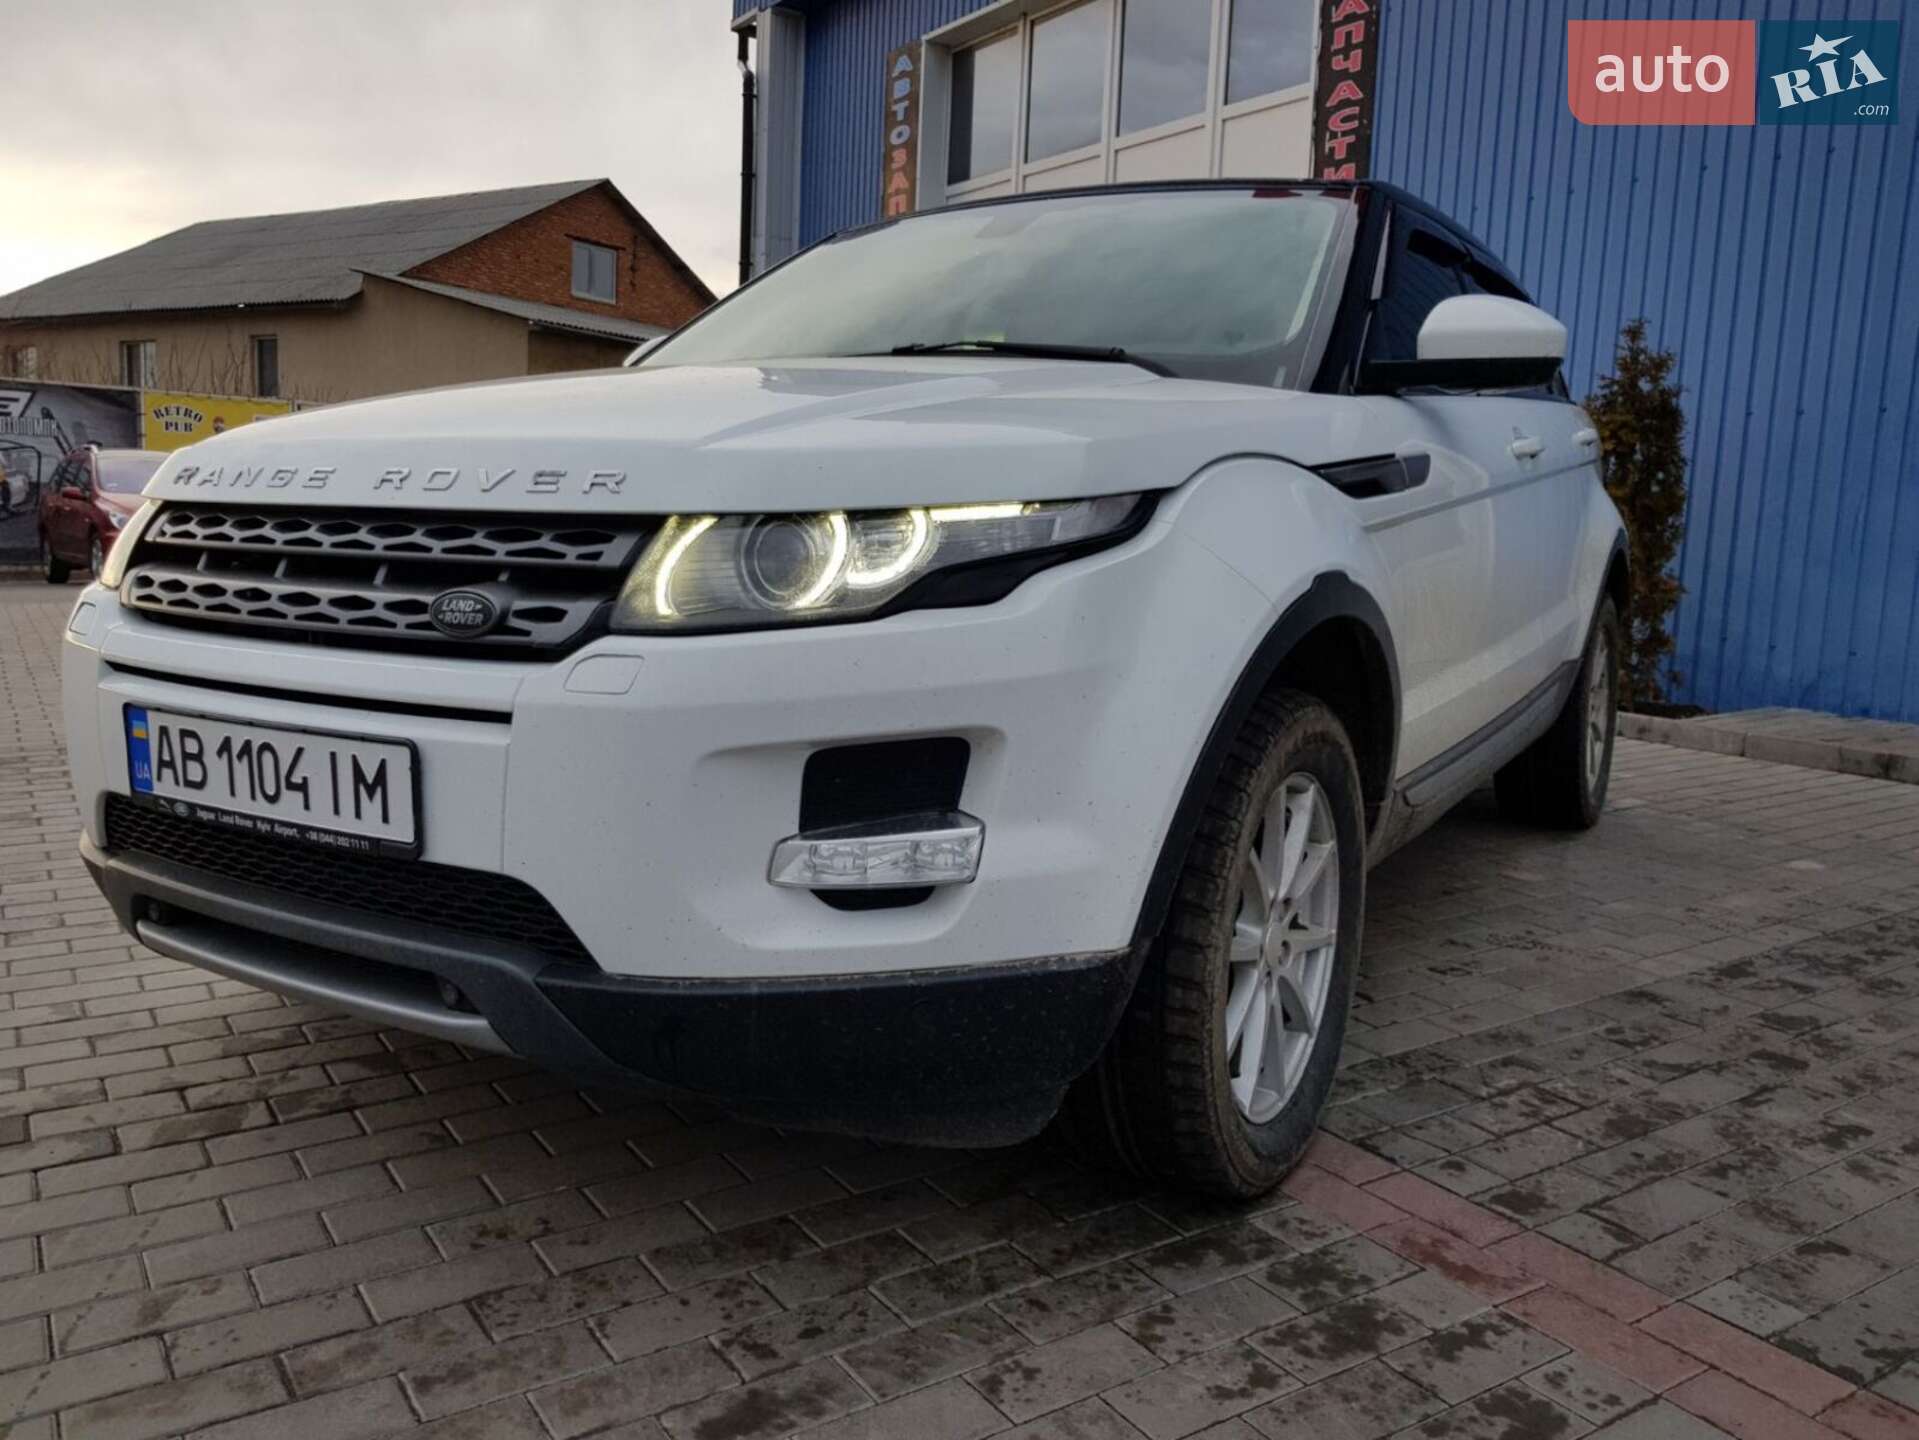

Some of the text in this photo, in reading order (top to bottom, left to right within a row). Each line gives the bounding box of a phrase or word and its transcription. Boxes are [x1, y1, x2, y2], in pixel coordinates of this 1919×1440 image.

[153, 405, 203, 423] RETRO
[164, 420, 193, 432] PUB
[173, 466, 628, 494] RANGE ROVER
[442, 600, 475, 612] LAND
[444, 612, 484, 624] ROVER
[135, 760, 151, 780] UA
